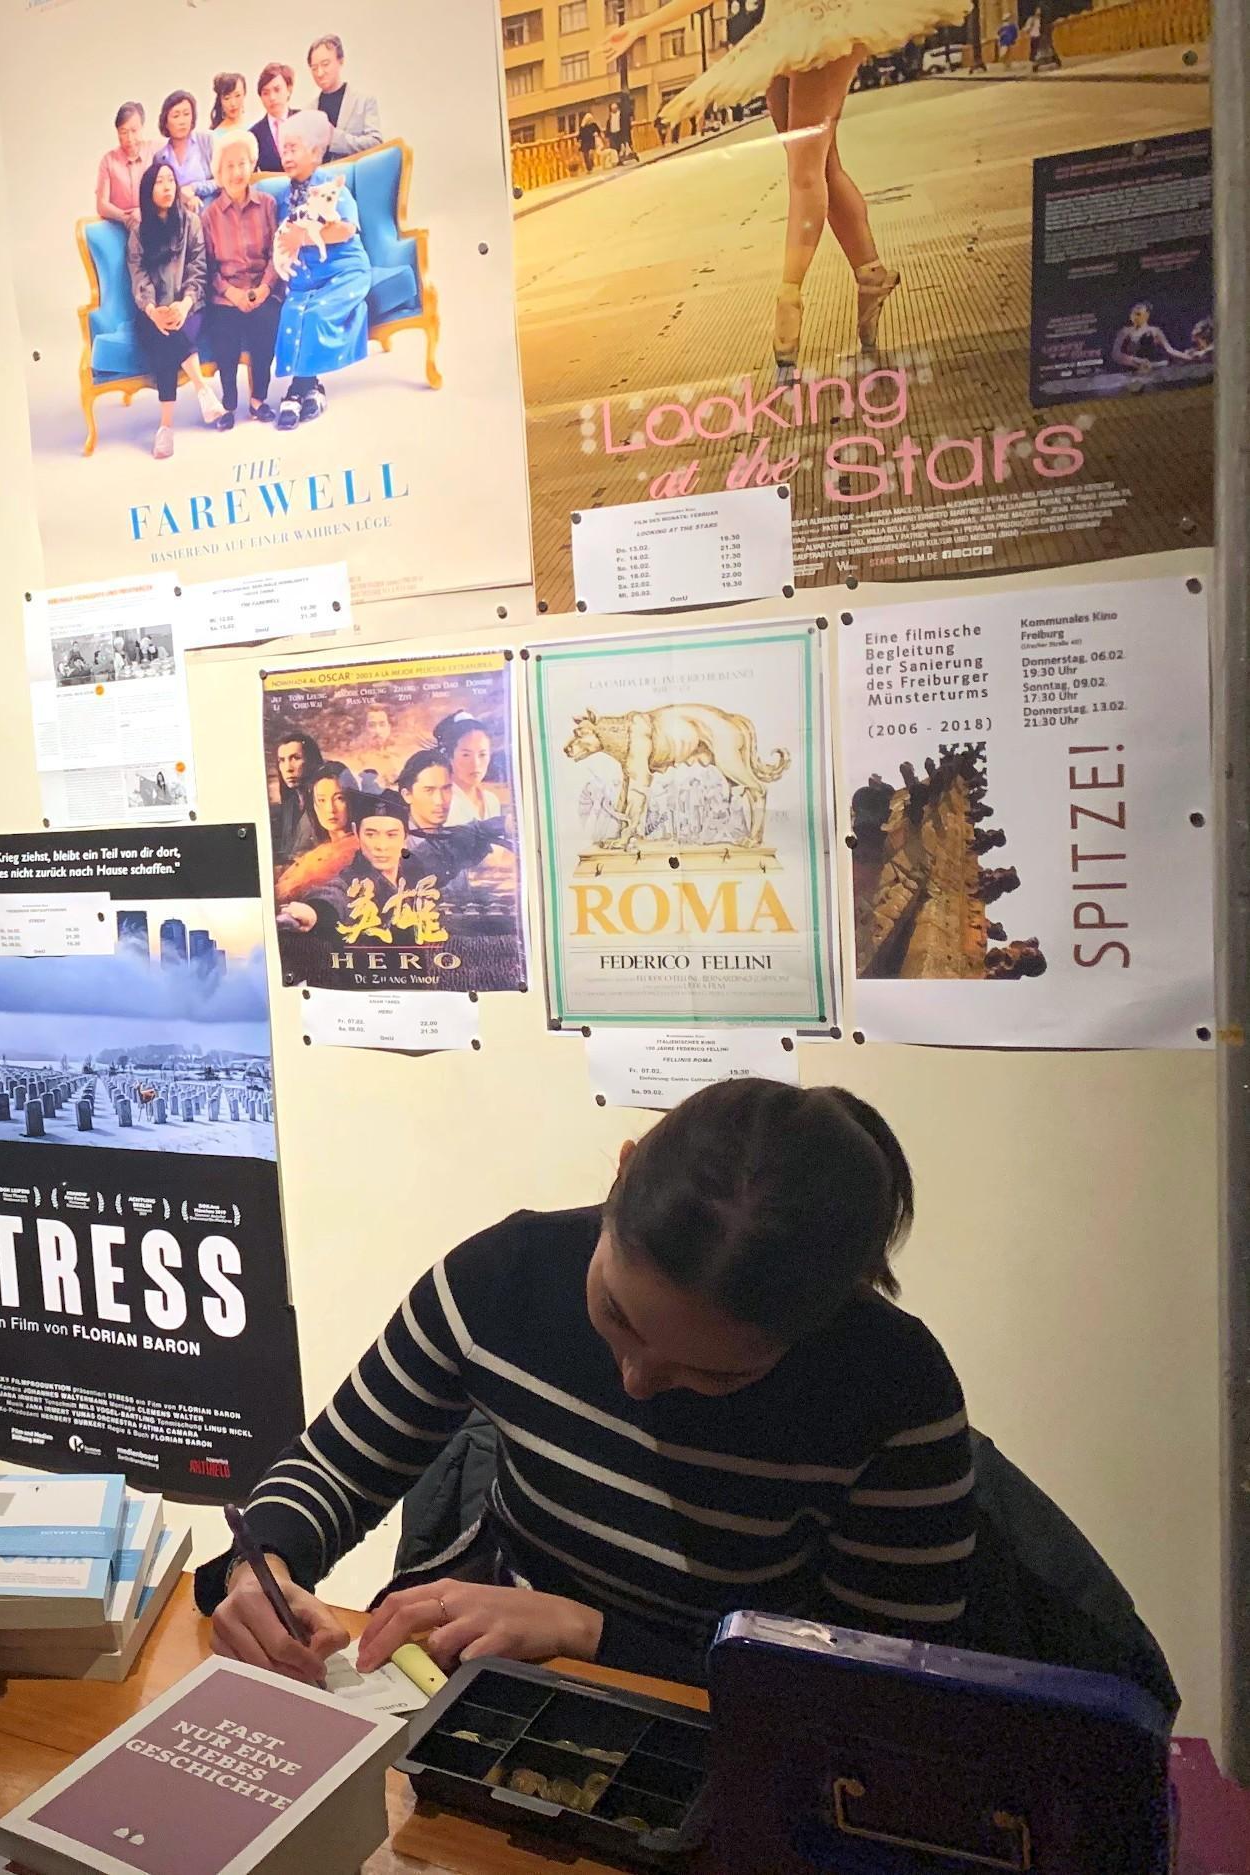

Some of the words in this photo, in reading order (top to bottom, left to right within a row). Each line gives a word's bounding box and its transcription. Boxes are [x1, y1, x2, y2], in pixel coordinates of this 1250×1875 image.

[602, 366, 909, 454] Looking
[233, 457, 281, 482] THE
[649, 460, 700, 499] at
[723, 436, 801, 489] the
[823, 423, 1086, 503] Stars
[128, 462, 410, 541] FAREWELL
[151, 542, 219, 563] BASIEREND
[224, 538, 246, 551] AUF
[250, 532, 289, 548] EINER
[293, 523, 351, 542] WAHREN
[356, 515, 393, 532] LÜGE
[1020, 613, 1091, 628] Kommunales
[1093, 610, 1118, 622] Kino
[865, 631, 899, 645] Eine
[905, 624, 982, 641] filmische
[1020, 628, 1065, 641] Freiburg
[866, 643, 956, 662] Begleitung
[866, 663, 893, 676] der
[899, 656, 984, 674] Sanierung
[1022, 667, 1055, 678] 19.30
[1058, 665, 1078, 676] Uhr
[318, 672, 350, 683] OSCAR
[867, 678, 894, 691] des
[900, 671, 990, 688] Freiburger
[868, 687, 990, 706] Münsterturms
[1023, 692, 1056, 703] 17.30
[1059, 690, 1078, 701] Uhr
[868, 721, 918, 738] (2006
[940, 717, 993, 733] 2018)
[1024, 717, 1057, 728] 21.30
[1060, 714, 1079, 725] Uhr
[21, 851, 51, 864] ziehst,
[53, 850, 80, 862] bleibt
[83, 850, 98, 861] ein
[101, 847, 118, 860] Teil
[120, 849, 137, 859] von
[139, 847, 154, 859] dir
[156, 847, 181, 860] dort,
[1068, 743, 1130, 968] SPITZE!
[11, 867, 34, 879] nicht
[36, 866, 67, 879] zurück
[69, 864, 93, 878] nach
[96, 864, 128, 876] Hause
[130, 861, 181, 876] schaffen."
[569, 879, 799, 935] ROMA
[330, 952, 462, 970] HERO
[600, 955, 690, 970] FEDERICO
[702, 955, 772, 970] FELLINI
[371, 974, 408, 985] ZHANG
[410, 974, 440, 985] YIMOU
[11, 1317, 39, 1332] Film
[44, 1322, 68, 1336] von
[72, 1325, 138, 1348] FLORIAN
[143, 1335, 200, 1356] BARON
[11, 1378, 72, 1392] FILMPRODUKTION
[108, 1392, 134, 1404] STRESS
[148, 1400, 162, 1408] Film
[178, 1404, 212, 1416] FLORIAN
[214, 1409, 242, 1420] BARON
[137, 1406, 171, 1418] CLEMENS
[172, 1412, 204, 1422] WALTER
[138, 1422, 164, 1433] FATIMA
[166, 1428, 198, 1438] CAMARA
[204, 1424, 228, 1434] LINUS
[229, 1428, 253, 1438] NICKL
[150, 1433, 184, 1444] FLORIAN
[185, 1438, 213, 1448] BARON
[215, 1719, 285, 1750] FAST
[172, 1720, 232, 1749] NUR
[234, 1743, 302, 1776] EINE
[174, 1738, 268, 1781] LIEBES
[125, 1739, 293, 1811] GESCHICHTE
